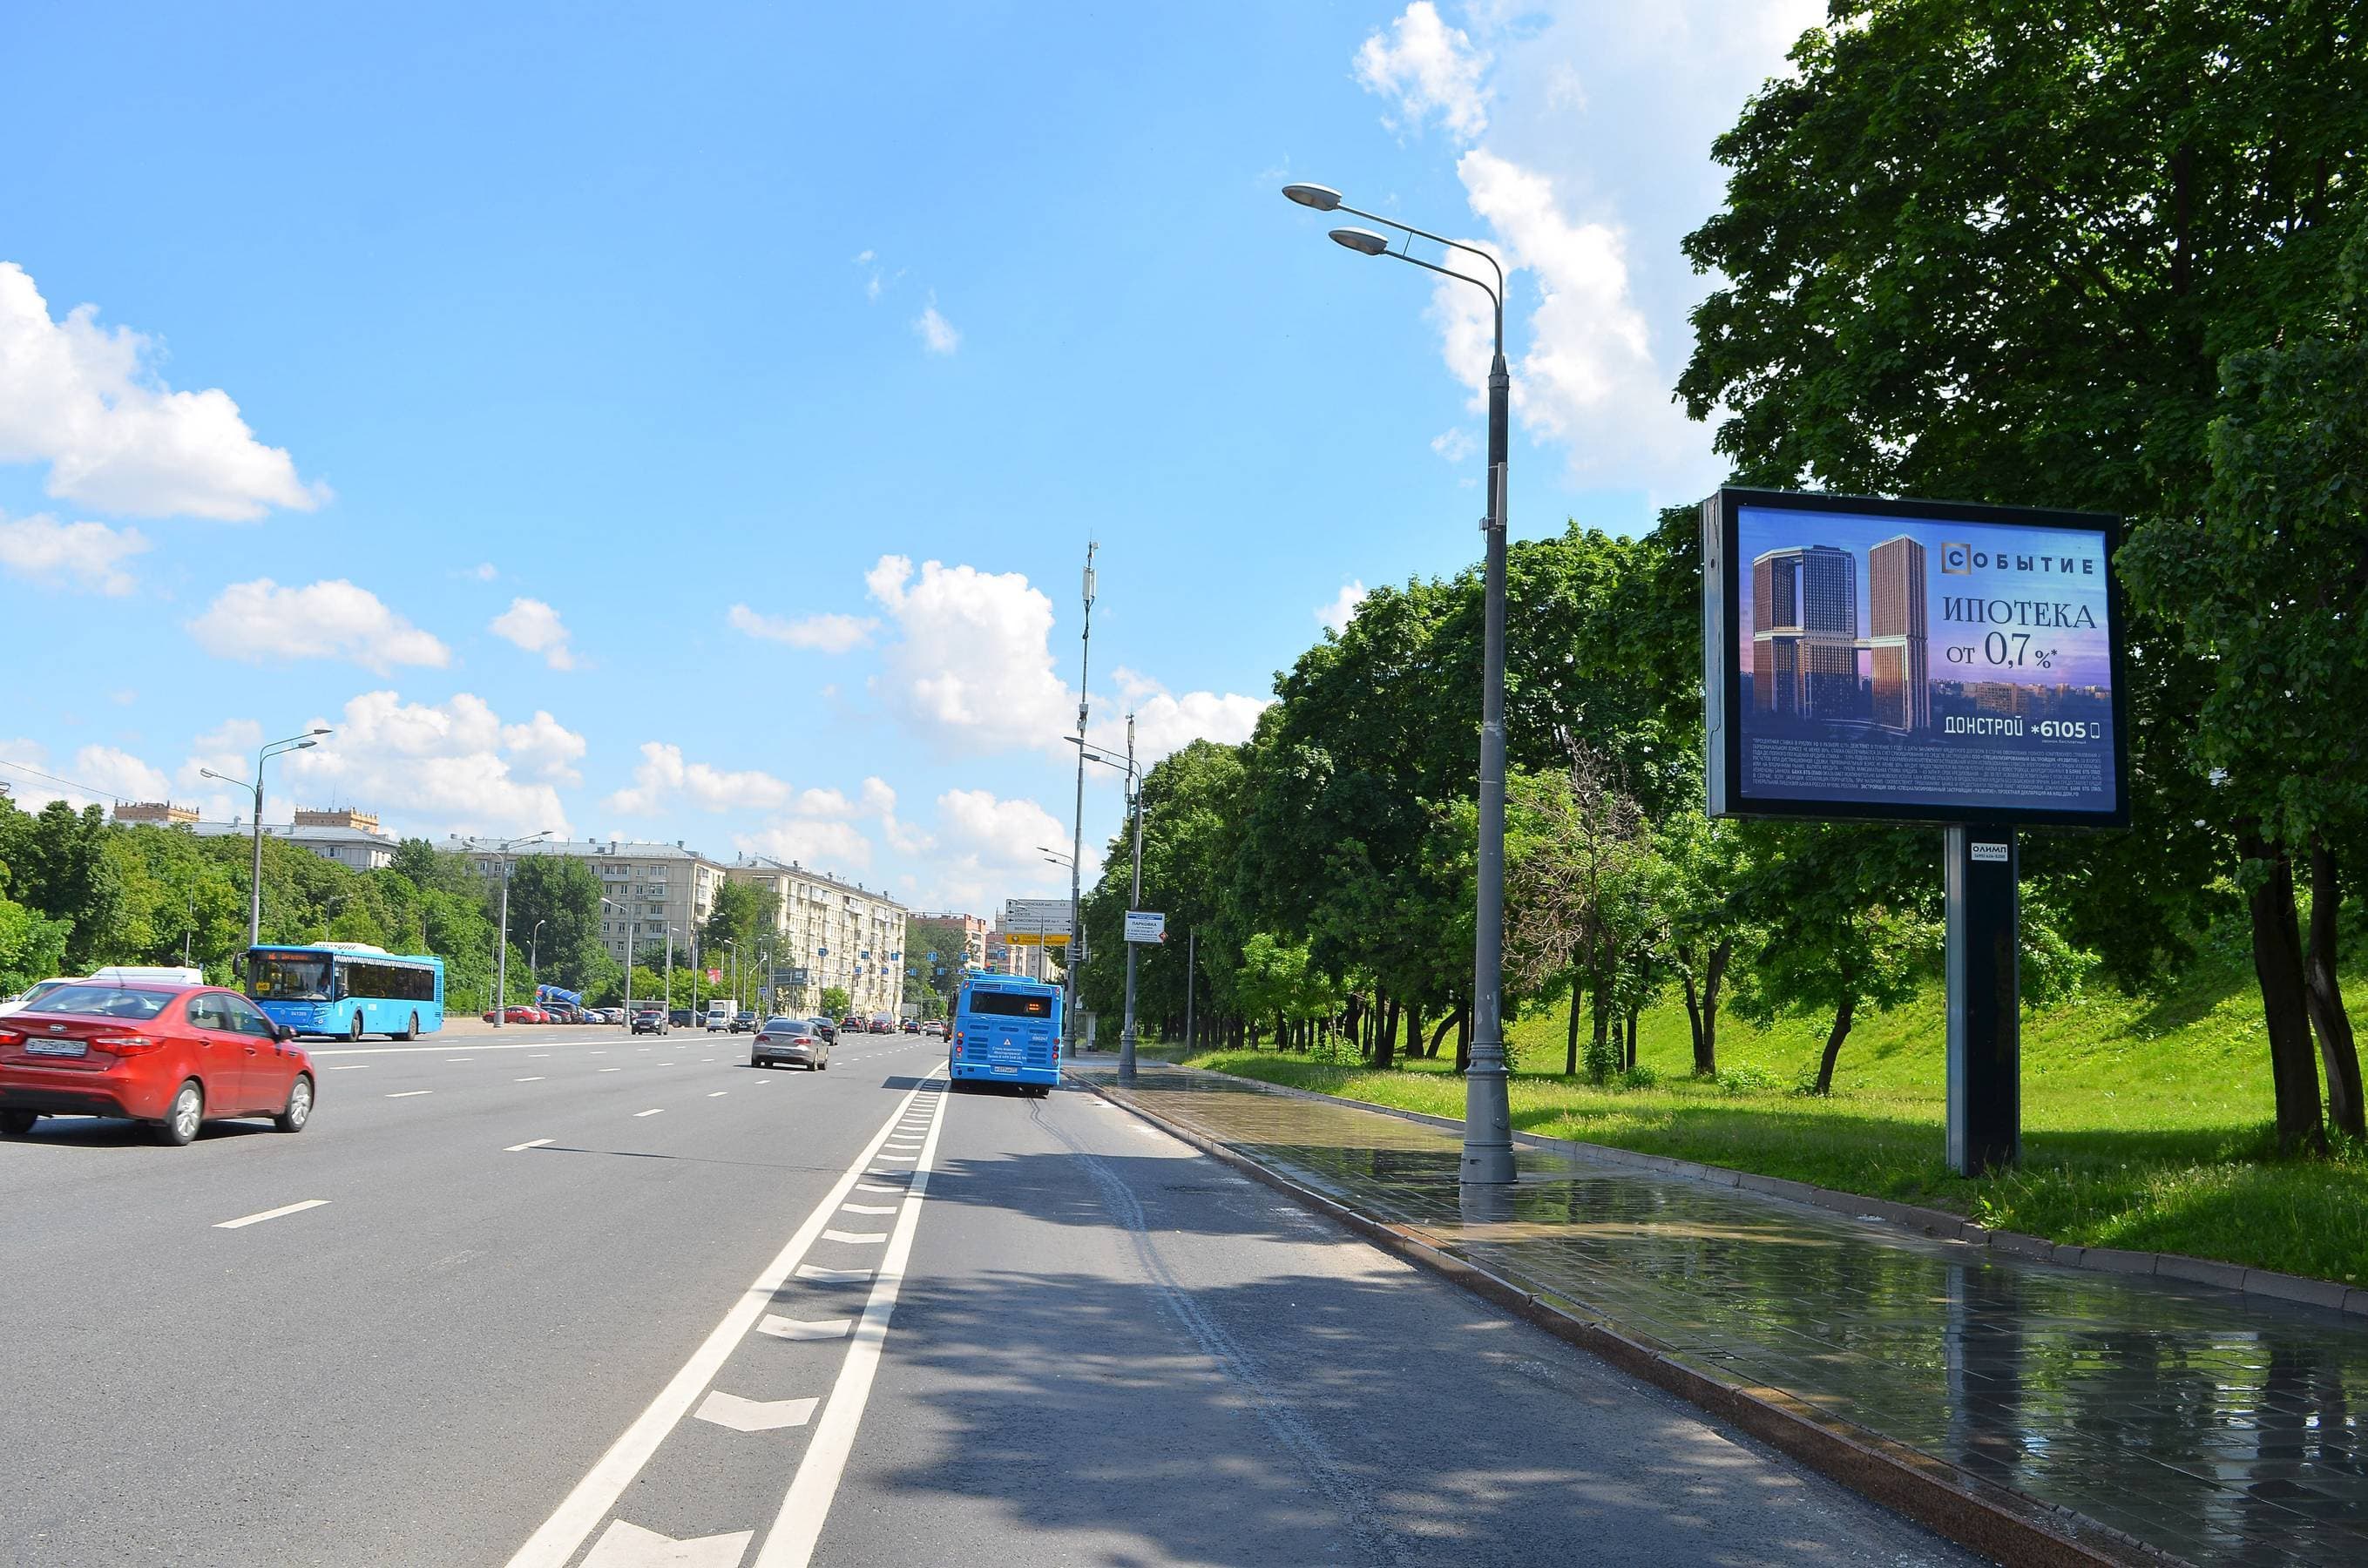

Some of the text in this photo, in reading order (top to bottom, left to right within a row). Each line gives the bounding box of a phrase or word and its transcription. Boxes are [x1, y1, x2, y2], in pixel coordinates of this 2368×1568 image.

[1949, 551, 2093, 574] СОБЫТИЕ
[1942, 596, 2097, 629] ИПОТЕКА
[1944, 715, 2023, 737] ДОНСТРОЙ
